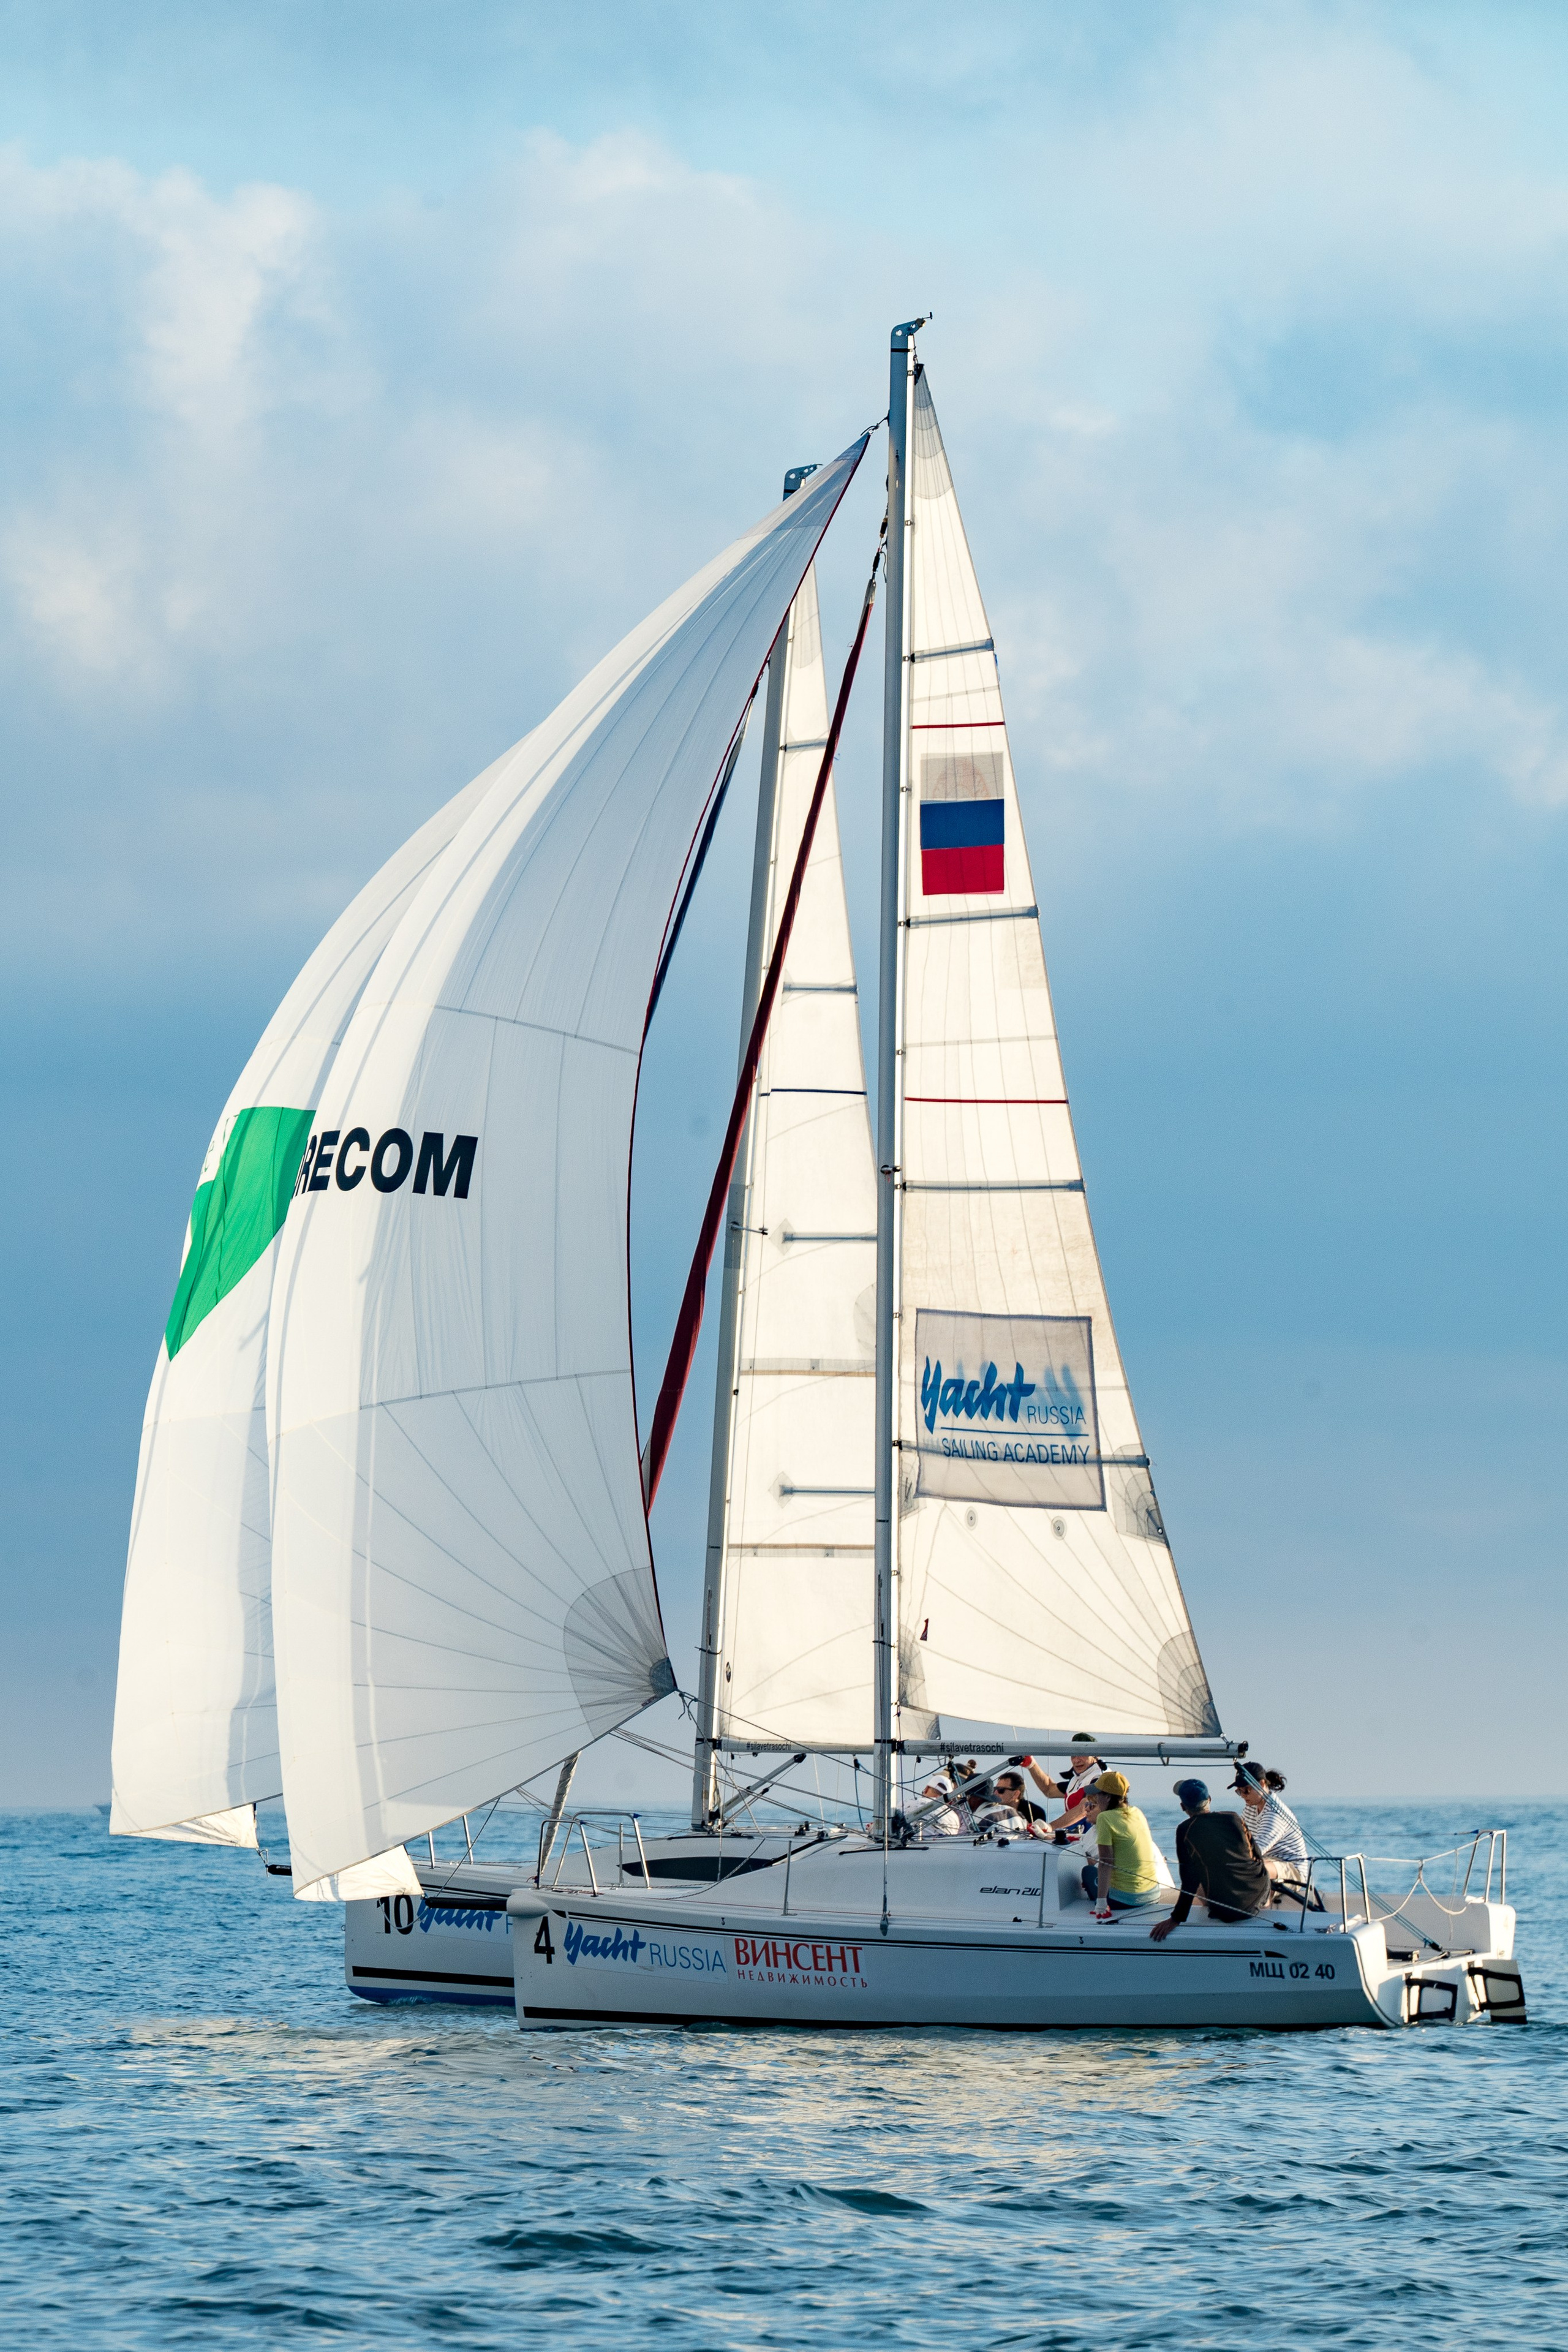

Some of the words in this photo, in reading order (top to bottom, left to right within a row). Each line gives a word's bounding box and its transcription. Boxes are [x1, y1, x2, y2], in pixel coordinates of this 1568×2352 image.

[290, 1127, 478, 1200] RECOM
[1027, 1406, 1087, 1425] RUSSIA
[941, 1438, 998, 1461] SAILING
[1003, 1442, 1090, 1464] ACADEMY
[747, 1741, 791, 1751] #silavetrasochi
[940, 1743, 1004, 1752] #silavetrasochi
[980, 1885, 1020, 1895] elan
[377, 1894, 414, 1935] 10
[534, 1916, 556, 1964] 4
[649, 1943, 726, 1973] RUSSIA
[734, 1937, 863, 1973] ВИНСЕНТ
[737, 1969, 868, 1988] НЕДВИЖИМОСТЬ
[1289, 1962, 1310, 1979] 02
[1315, 1964, 1335, 1980] 40
